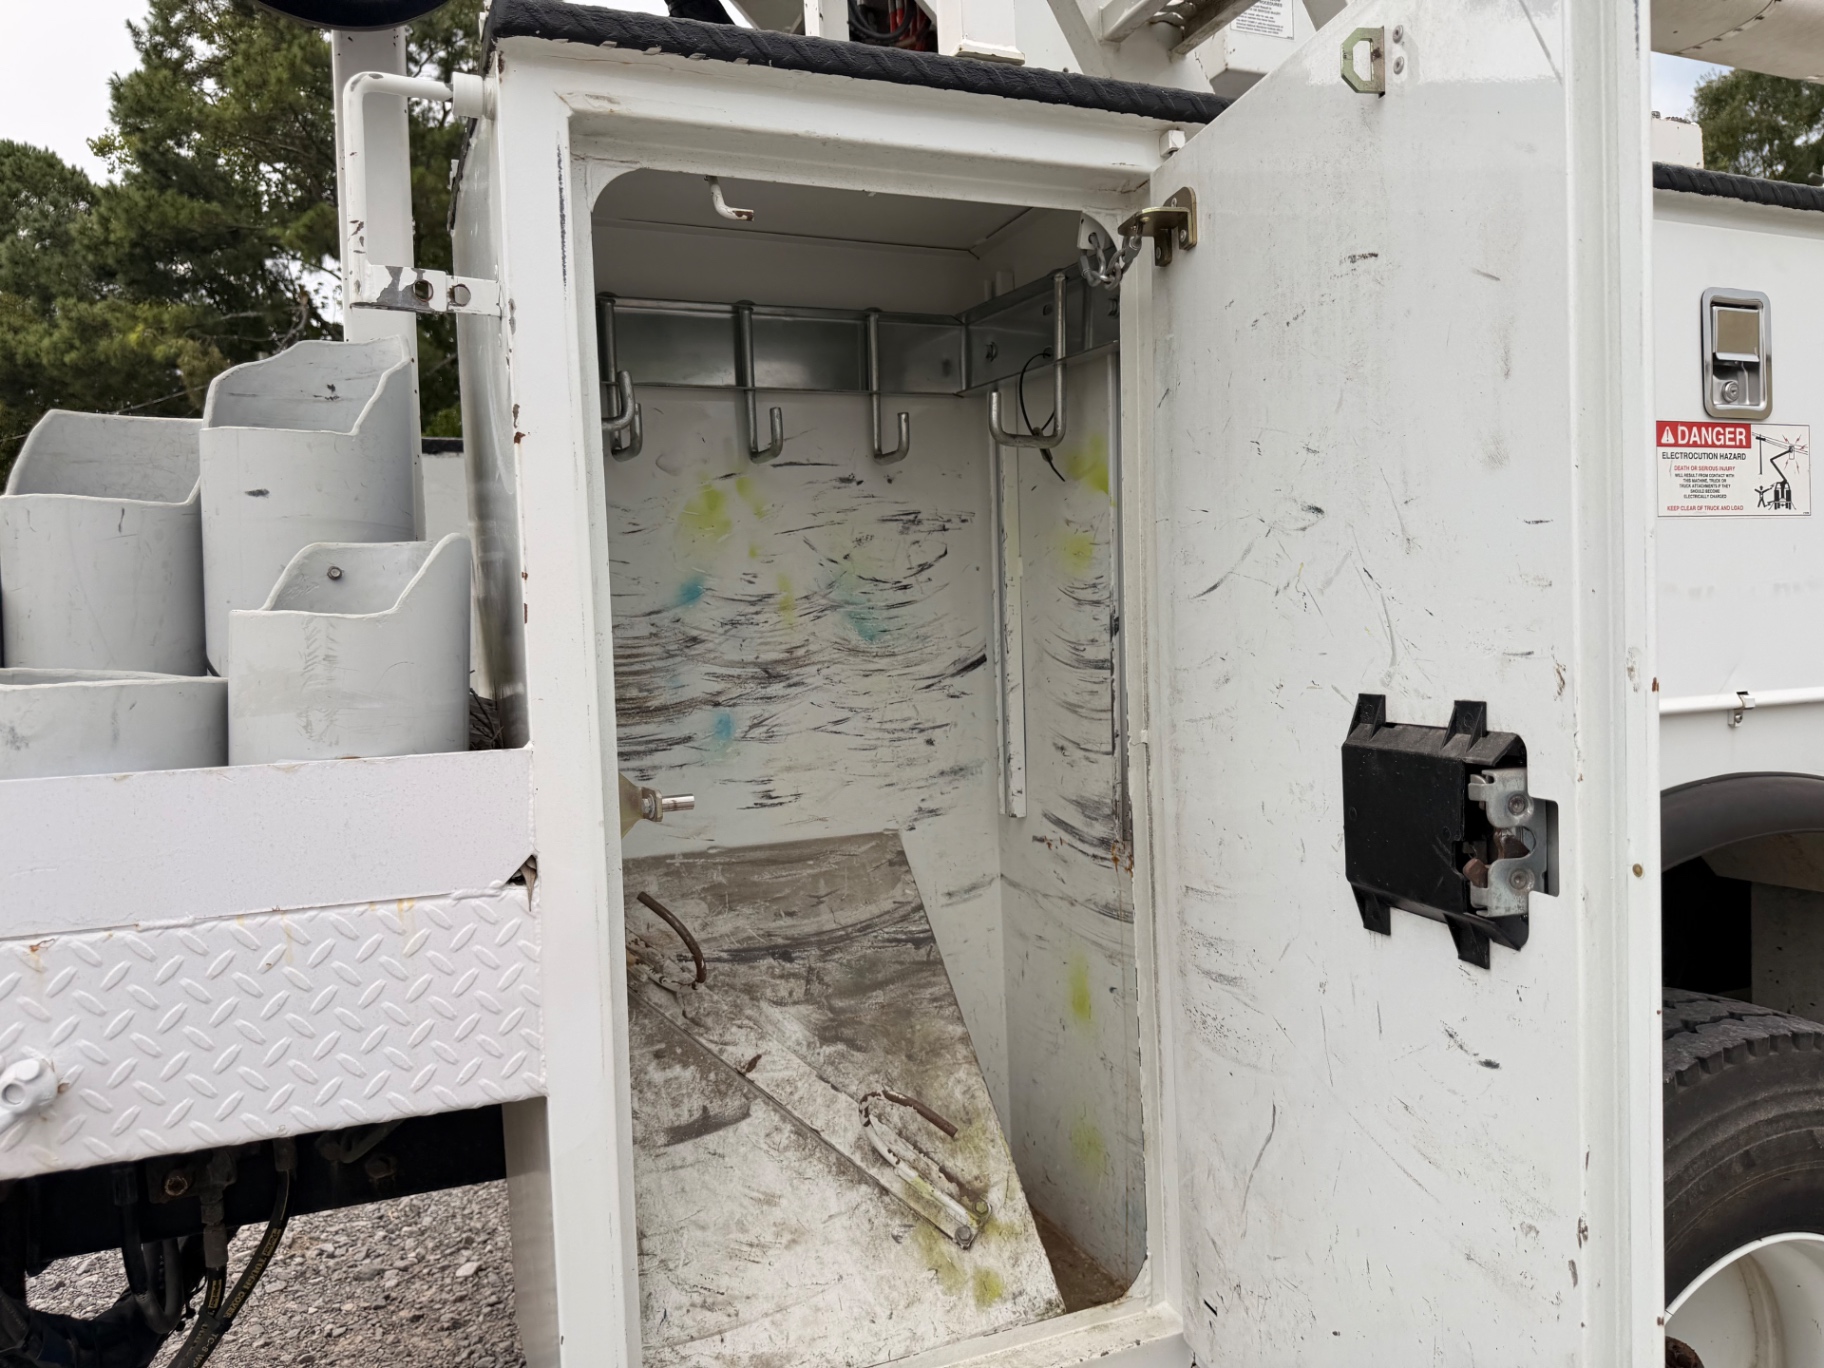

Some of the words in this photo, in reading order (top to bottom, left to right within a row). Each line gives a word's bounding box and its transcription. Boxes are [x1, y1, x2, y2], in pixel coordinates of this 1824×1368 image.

[1677, 425, 1746, 446] DANGER
[1662, 451, 1718, 460] ELECTROCUTION
[1719, 452, 1746, 460] HAZARD
